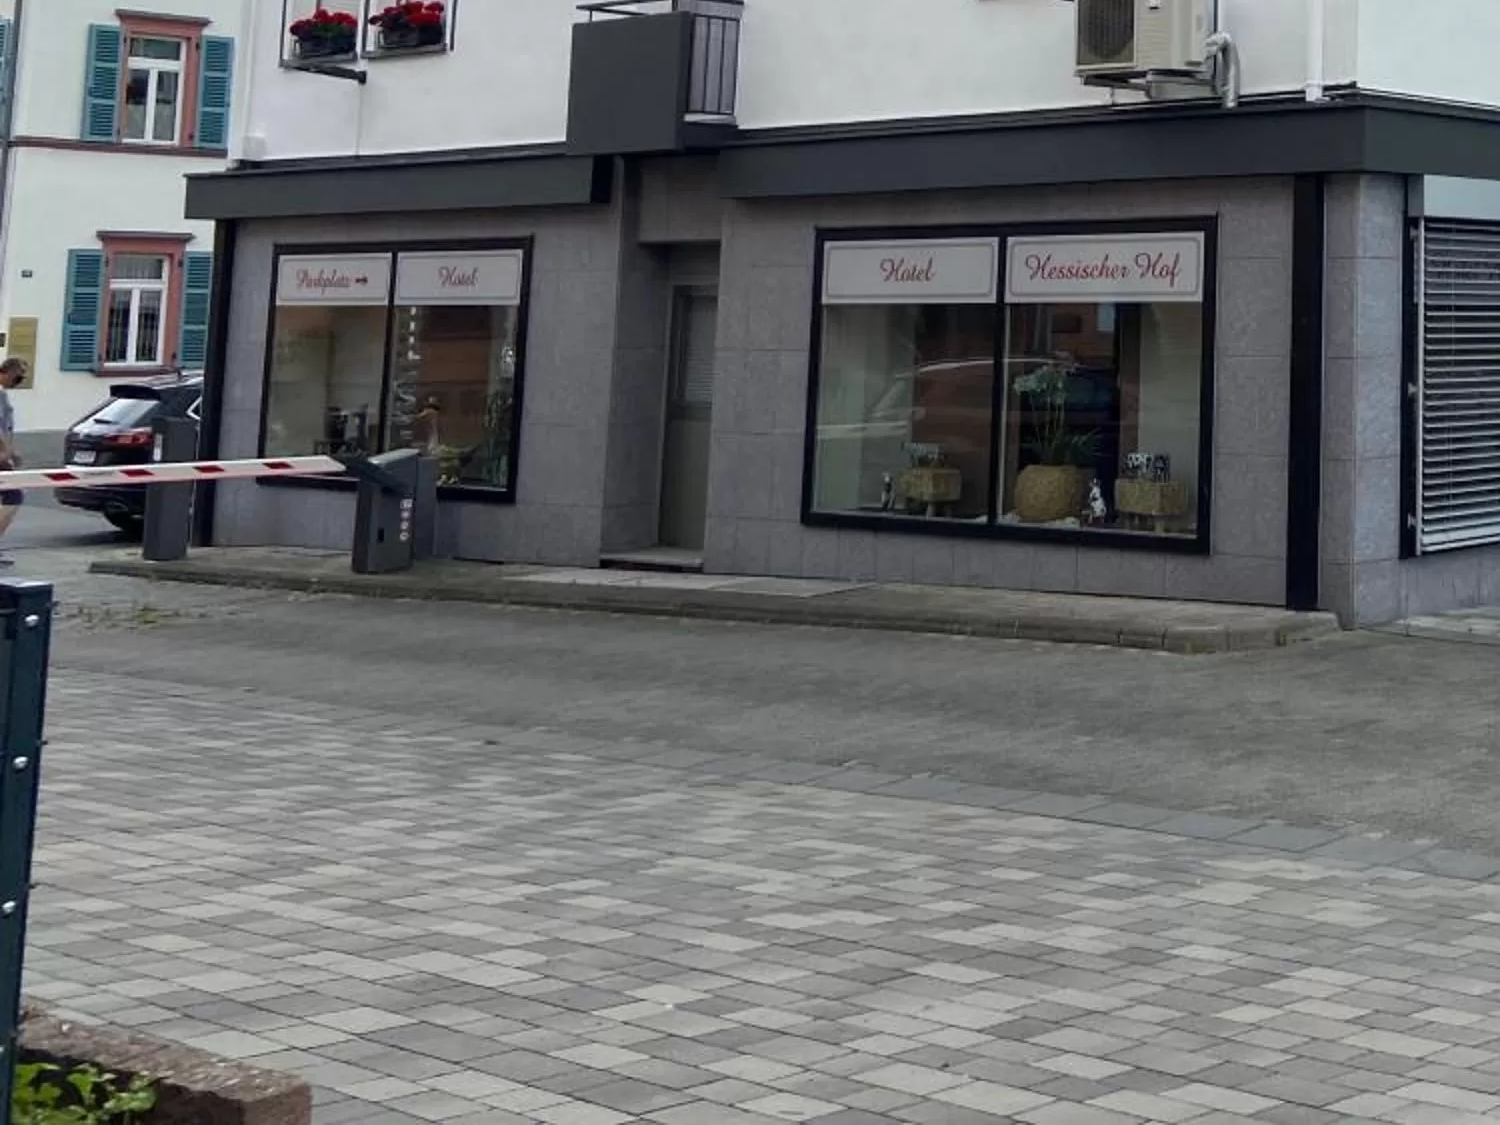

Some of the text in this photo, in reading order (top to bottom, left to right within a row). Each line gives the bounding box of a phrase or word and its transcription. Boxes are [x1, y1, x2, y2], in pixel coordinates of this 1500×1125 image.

[438, 266, 479, 288] Hotel
[879, 256, 937, 283] Hotel
[1025, 251, 1181, 288] Hessischer Hof
